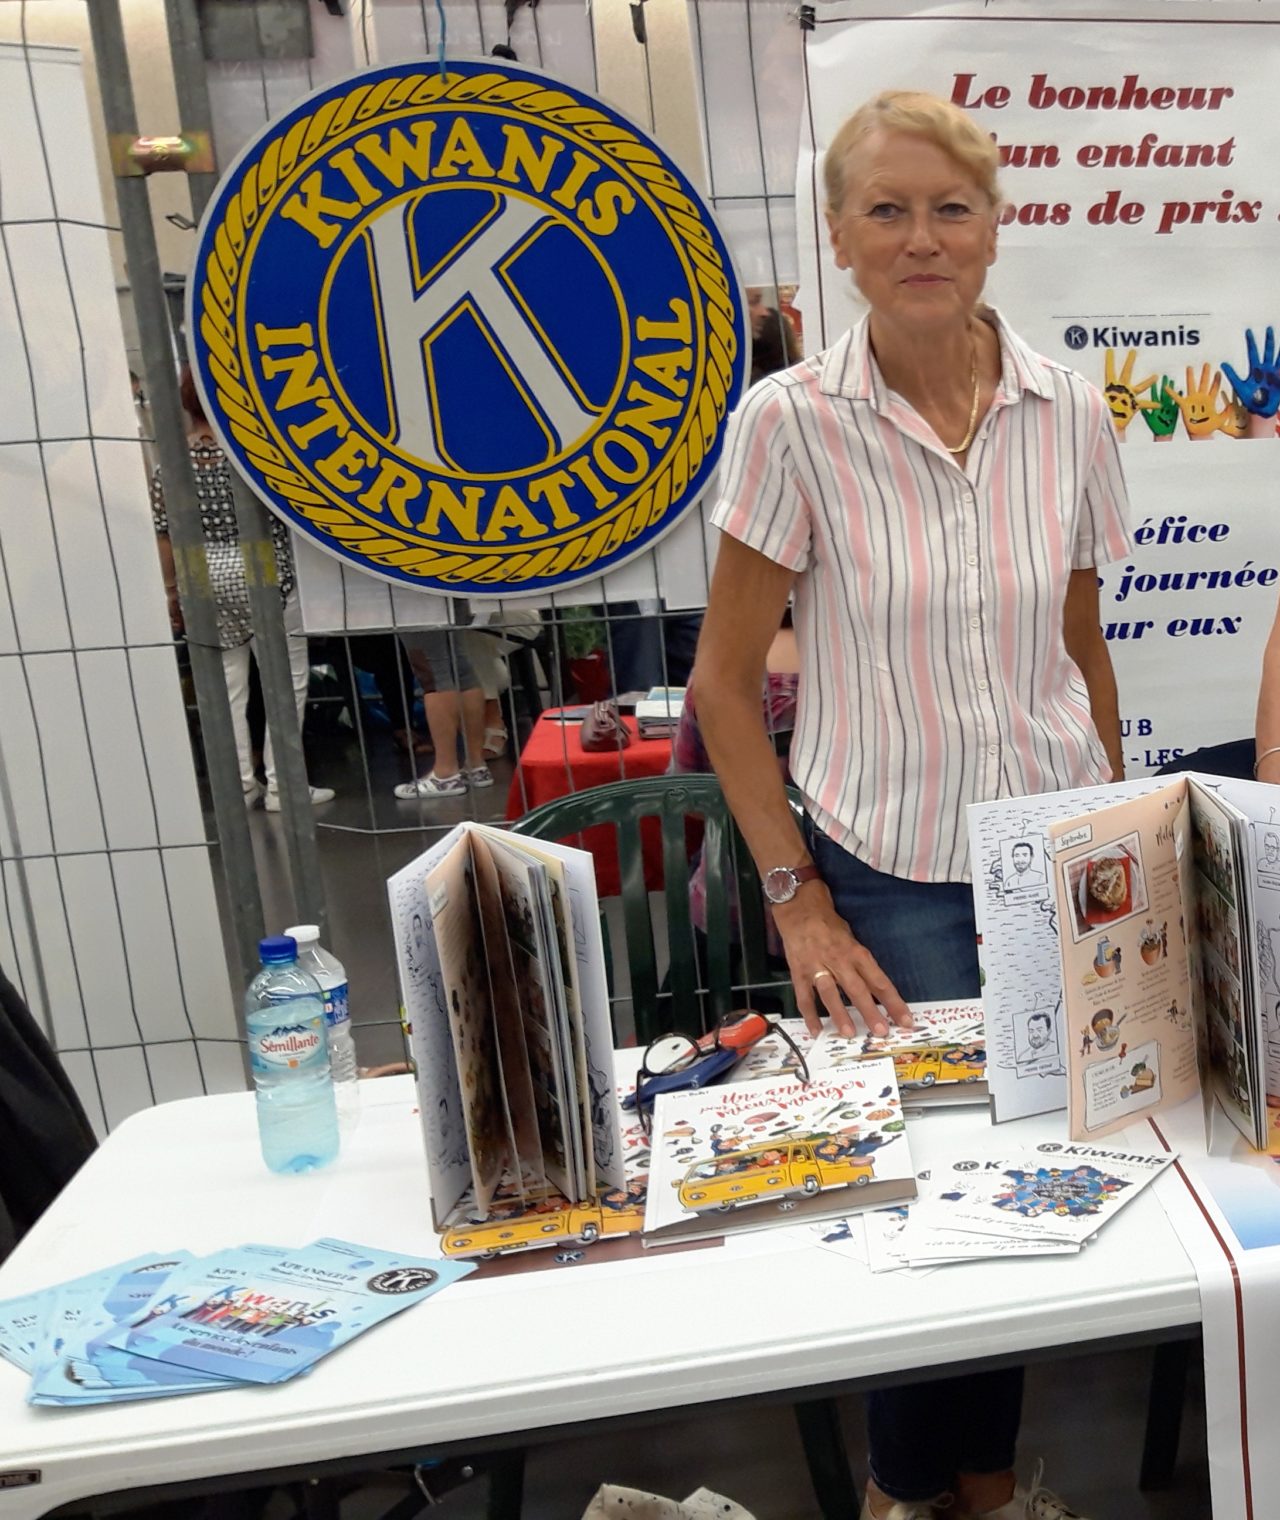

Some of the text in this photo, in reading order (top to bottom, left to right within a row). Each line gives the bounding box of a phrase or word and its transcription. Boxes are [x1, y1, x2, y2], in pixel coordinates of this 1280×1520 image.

[950, 73, 1235, 111] Le bonheur
[989, 132, 1236, 169] 'un enfant
[280, 117, 636, 250] KIWANIS
[1086, 191, 1146, 227] de
[1155, 190, 1262, 235] prix
[366, 191, 602, 473] K
[1093, 325, 1201, 348] Kiwanis
[255, 297, 693, 542] INTERNATIONAL
[1134, 515, 1231, 546] éfice
[1115, 561, 1279, 602] journée
[1100, 615, 1243, 641] ur eux
[721, 1089, 762, 1104] Une
[1063, 1145, 1169, 1165] Kiwanis
